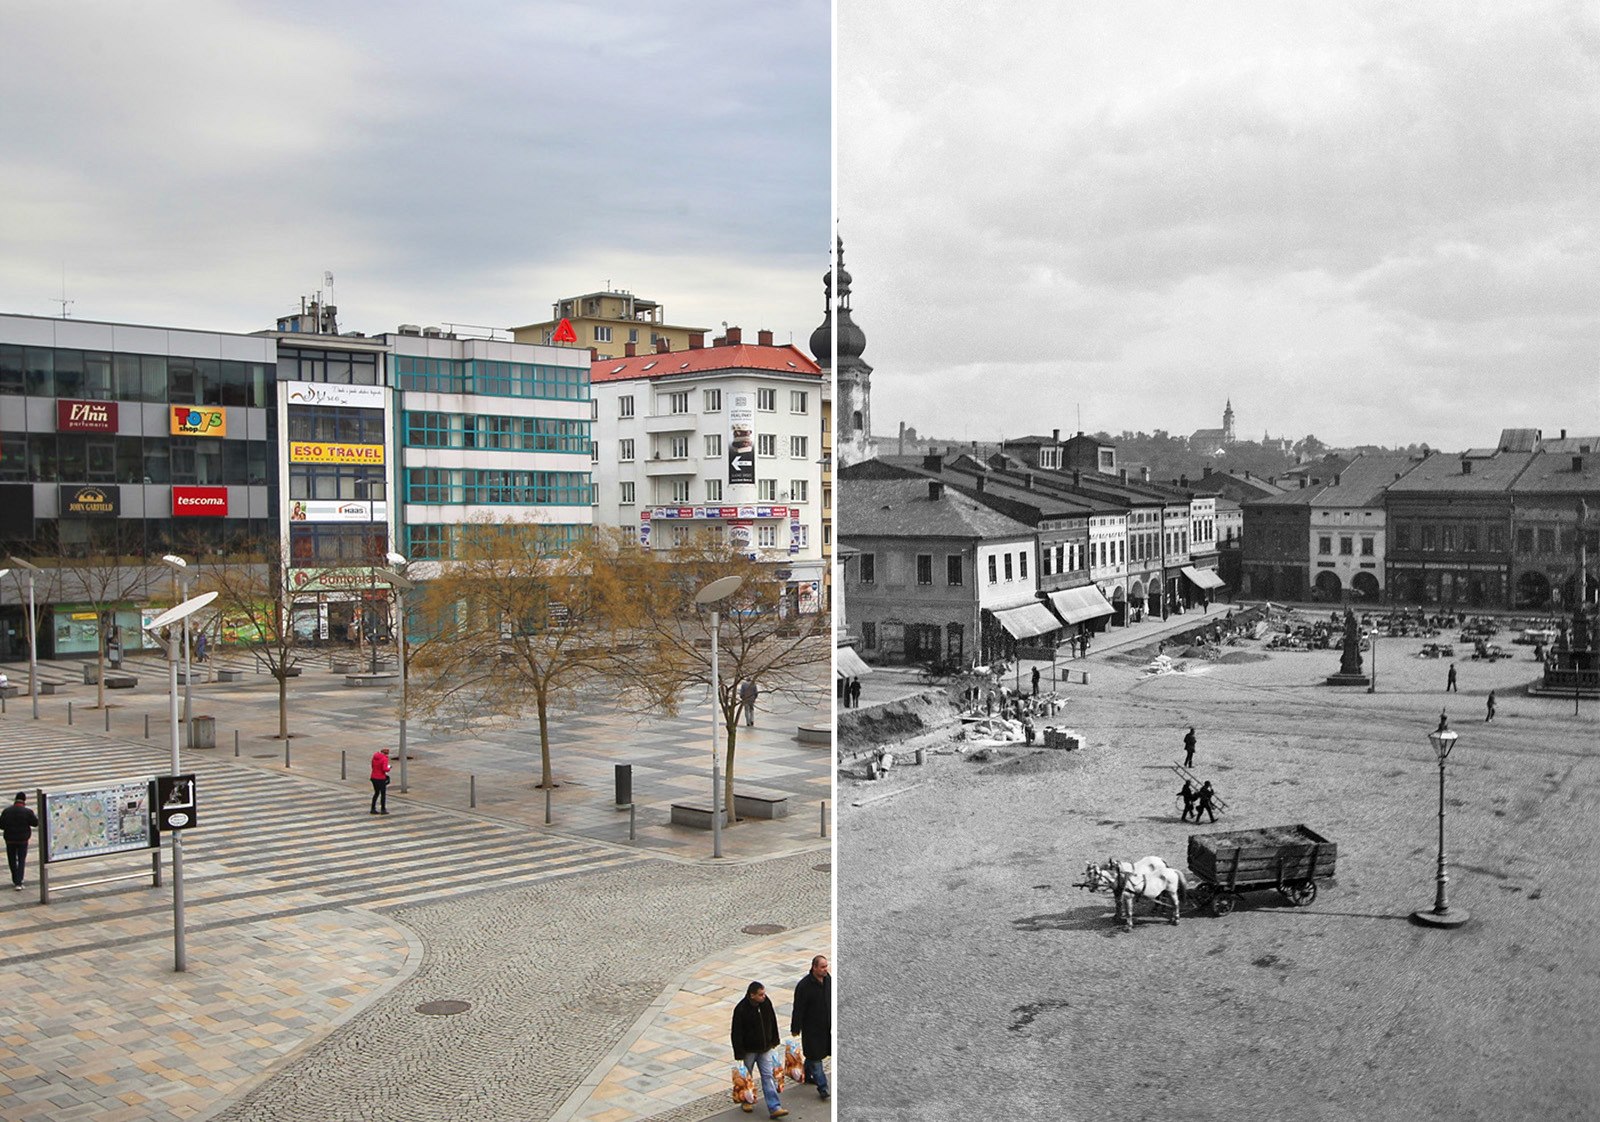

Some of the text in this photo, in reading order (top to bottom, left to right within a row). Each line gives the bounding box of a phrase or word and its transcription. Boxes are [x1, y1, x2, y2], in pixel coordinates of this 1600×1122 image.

[295, 446, 381, 458] ESO TRAVEL
[70, 503, 113, 511] JOHN GARFIELD
